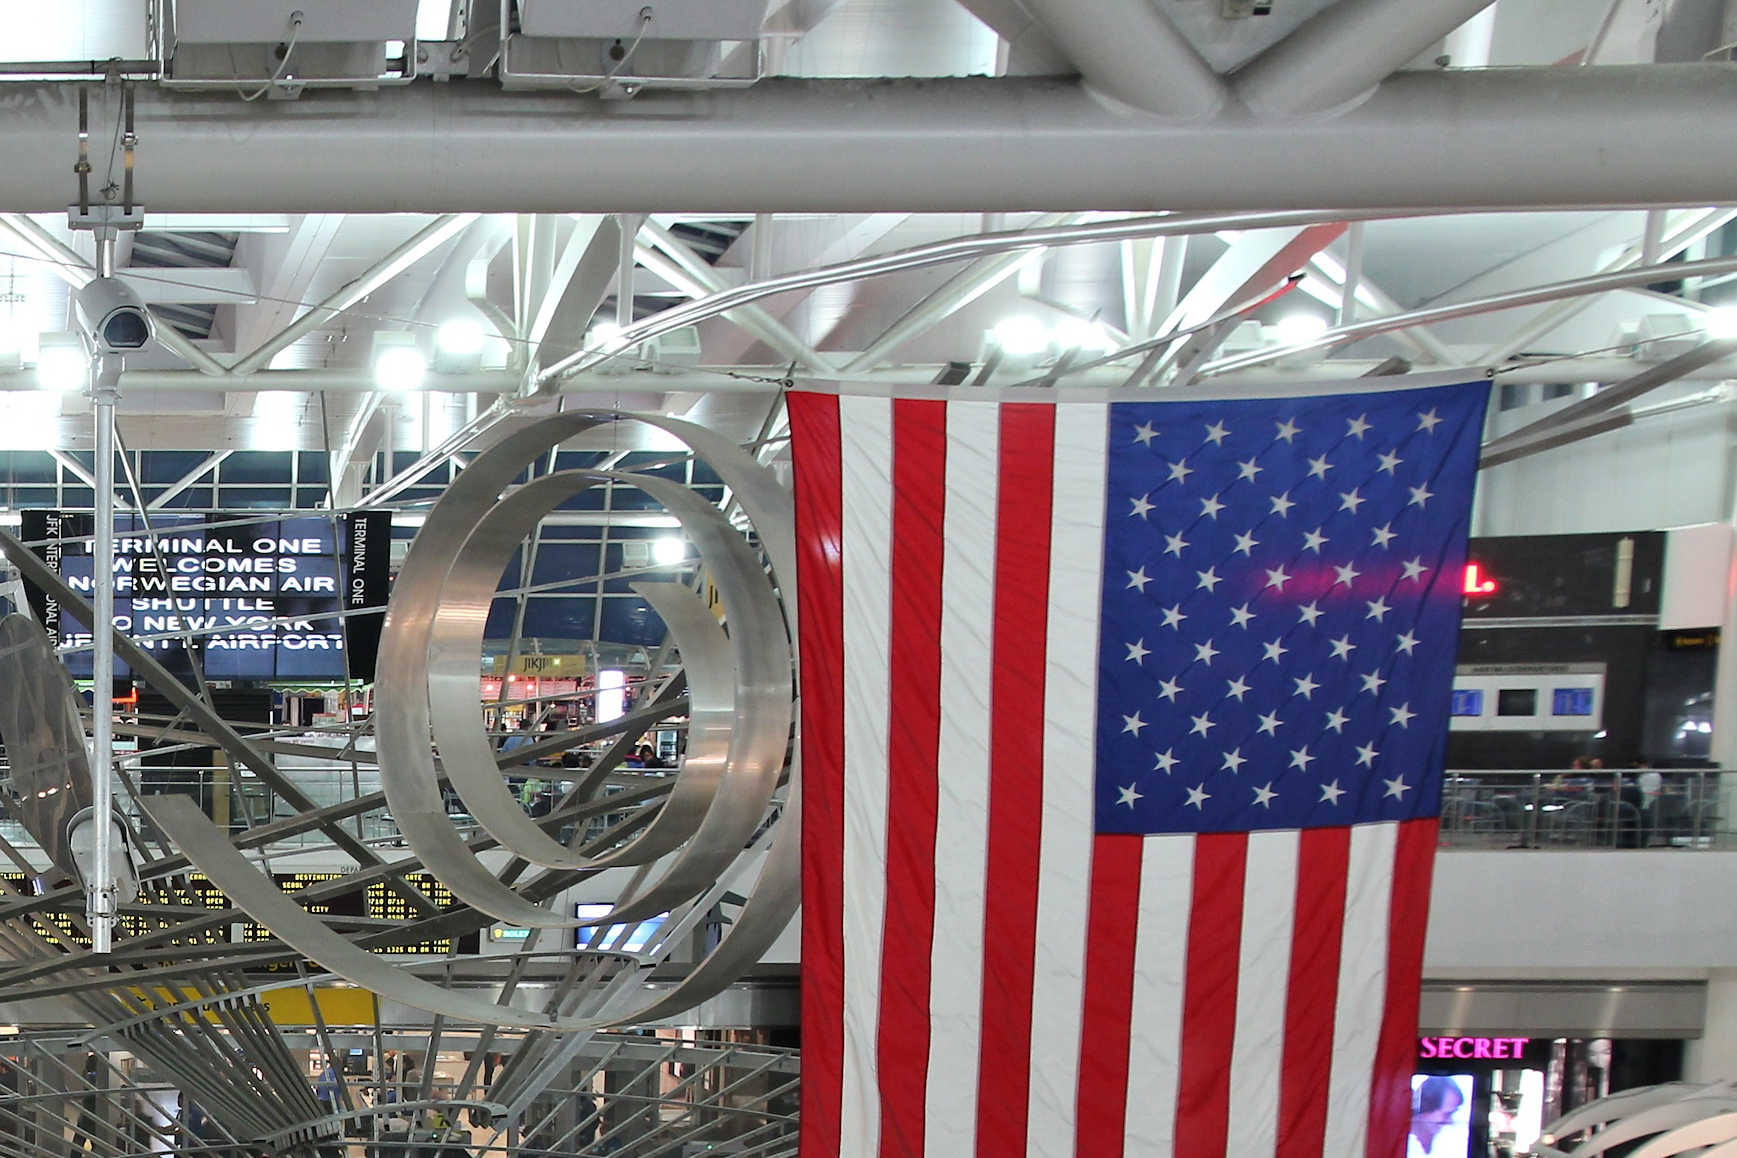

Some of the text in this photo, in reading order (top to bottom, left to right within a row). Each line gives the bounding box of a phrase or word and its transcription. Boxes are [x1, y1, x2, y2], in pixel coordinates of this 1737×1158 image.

[252, 538, 322, 553] ONE
[351, 517, 367, 605] TERMINAL ONE
[68, 576, 335, 592] NRWEGIAN AIR
[111, 616, 132, 631] O
[143, 616, 216, 631] NEW
[60, 633, 94, 648] JF
[207, 634, 344, 649] AIRPORT
[1420, 1037, 1529, 1059] SECRET
